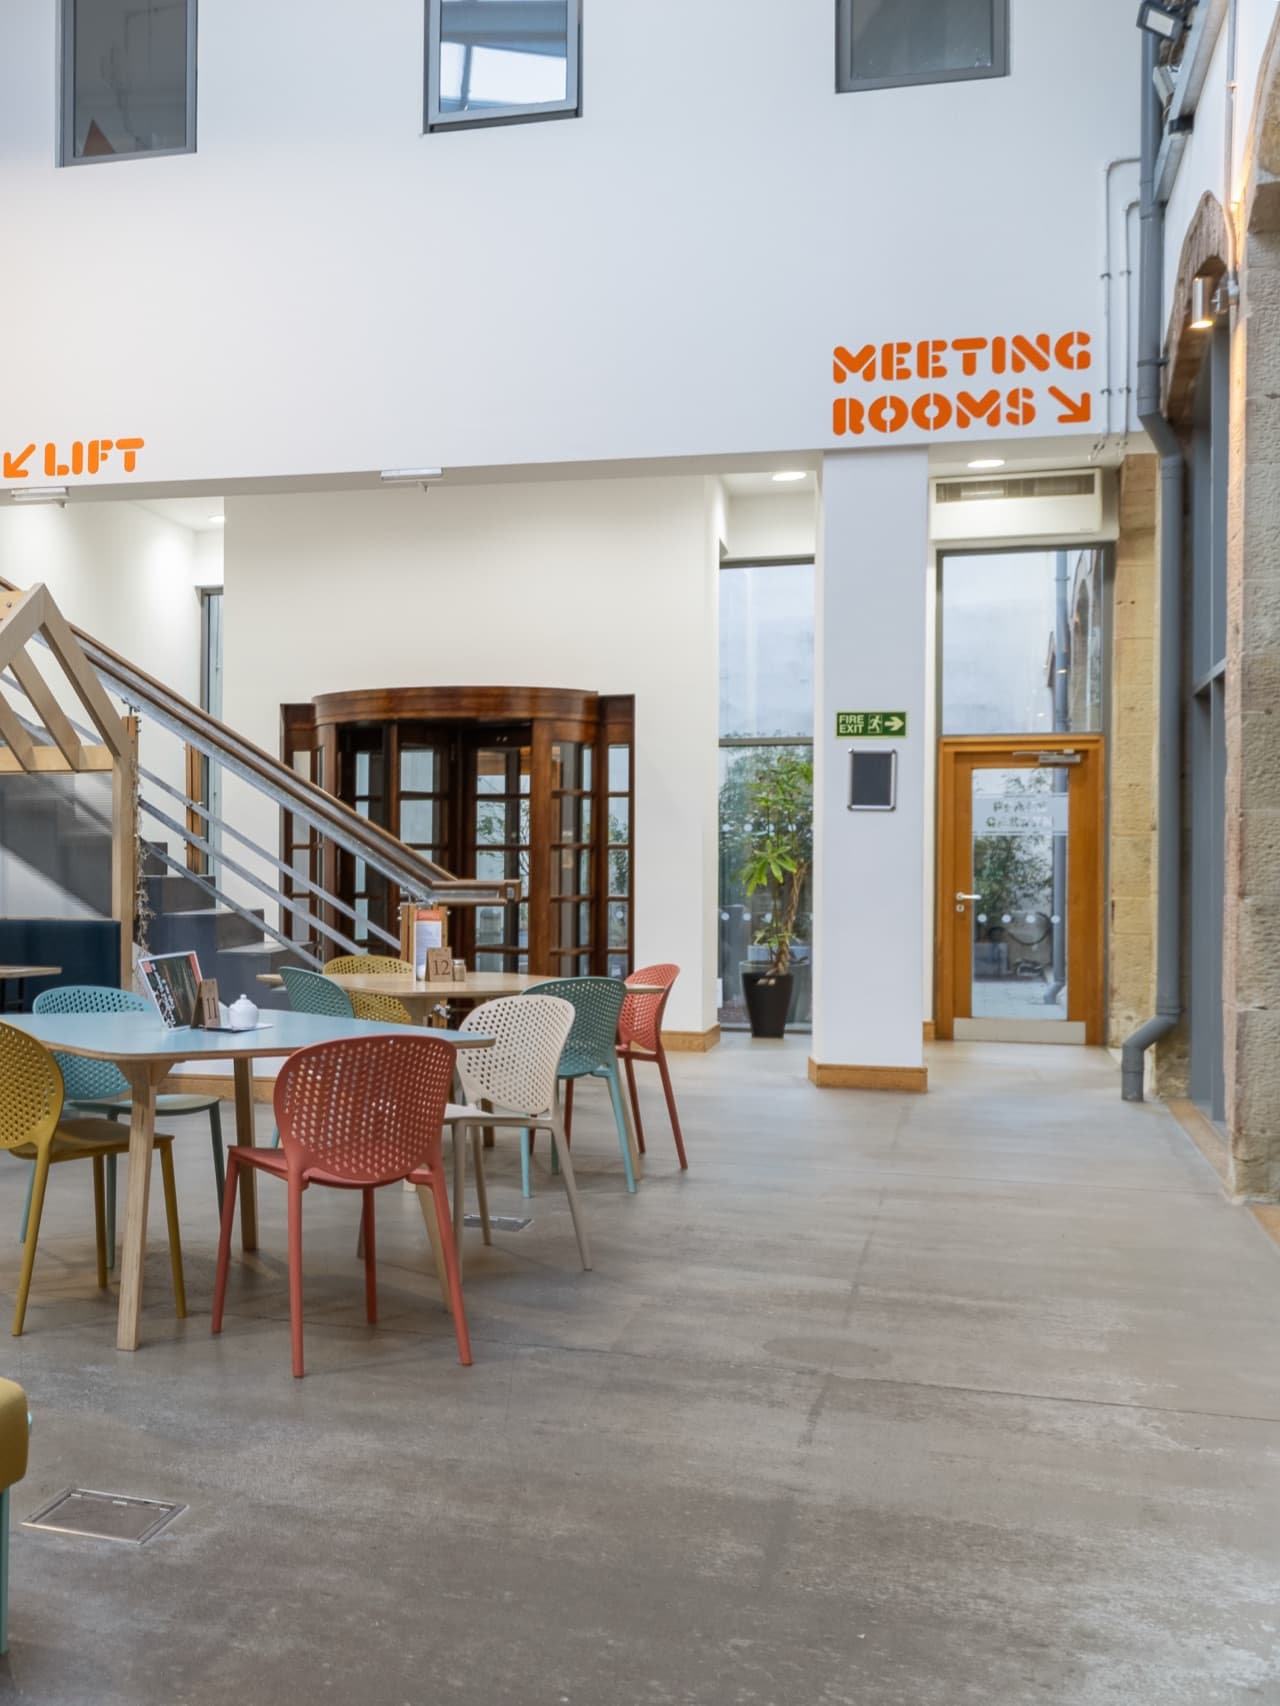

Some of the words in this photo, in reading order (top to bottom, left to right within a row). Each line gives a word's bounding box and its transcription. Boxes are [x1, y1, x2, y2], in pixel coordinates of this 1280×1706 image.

[833, 331, 1091, 384] MEETING
[833, 387, 1036, 436] ROOMS
[44, 437, 145, 476] LIFT
[839, 714, 865, 724] FIRE
[839, 724, 864, 734] EXIT
[433, 959, 451, 976] 12
[206, 997, 219, 1020] 11
